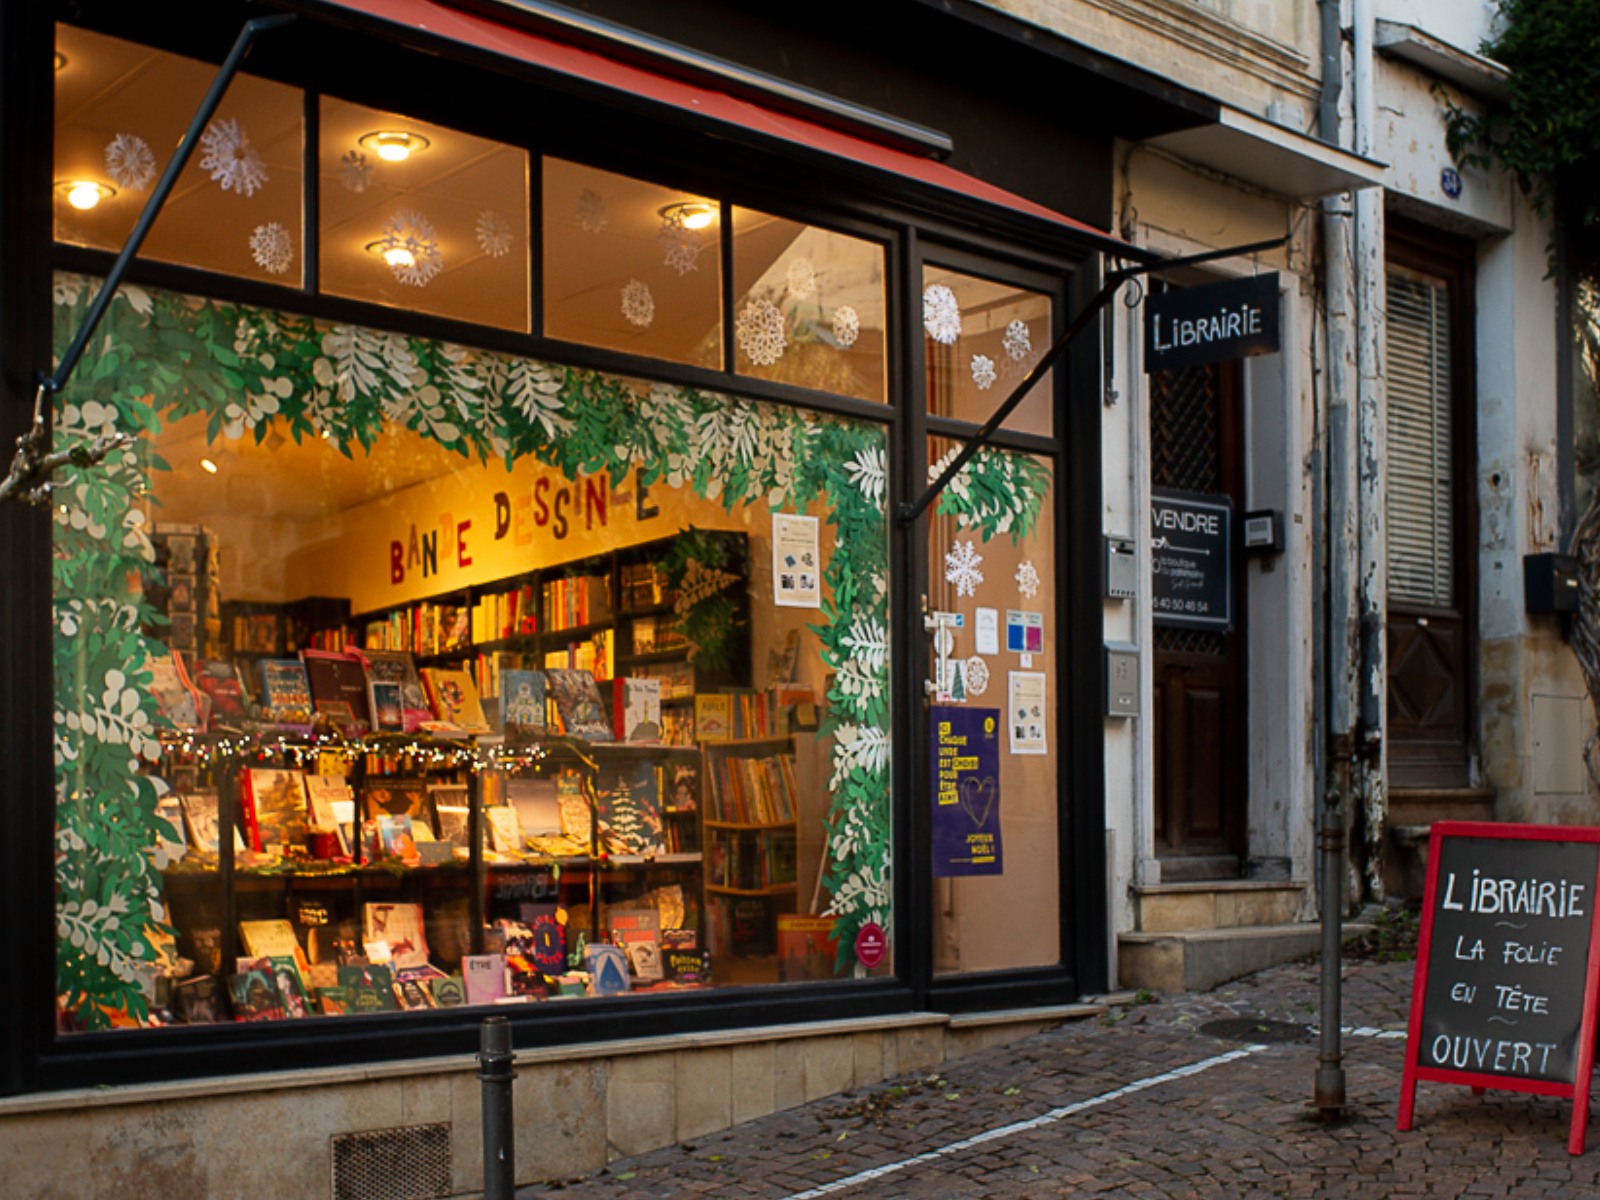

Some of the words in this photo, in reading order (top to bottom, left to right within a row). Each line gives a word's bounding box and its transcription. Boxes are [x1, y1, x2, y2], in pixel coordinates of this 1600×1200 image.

[1152, 508, 1219, 535] VENDRE
[390, 511, 473, 585] BANDE
[1455, 935, 1485, 961] LA
[1450, 982, 1477, 1003] EN
[1494, 984, 1549, 1014] TÊTE
[1432, 1034, 1557, 1074] OUVERT
